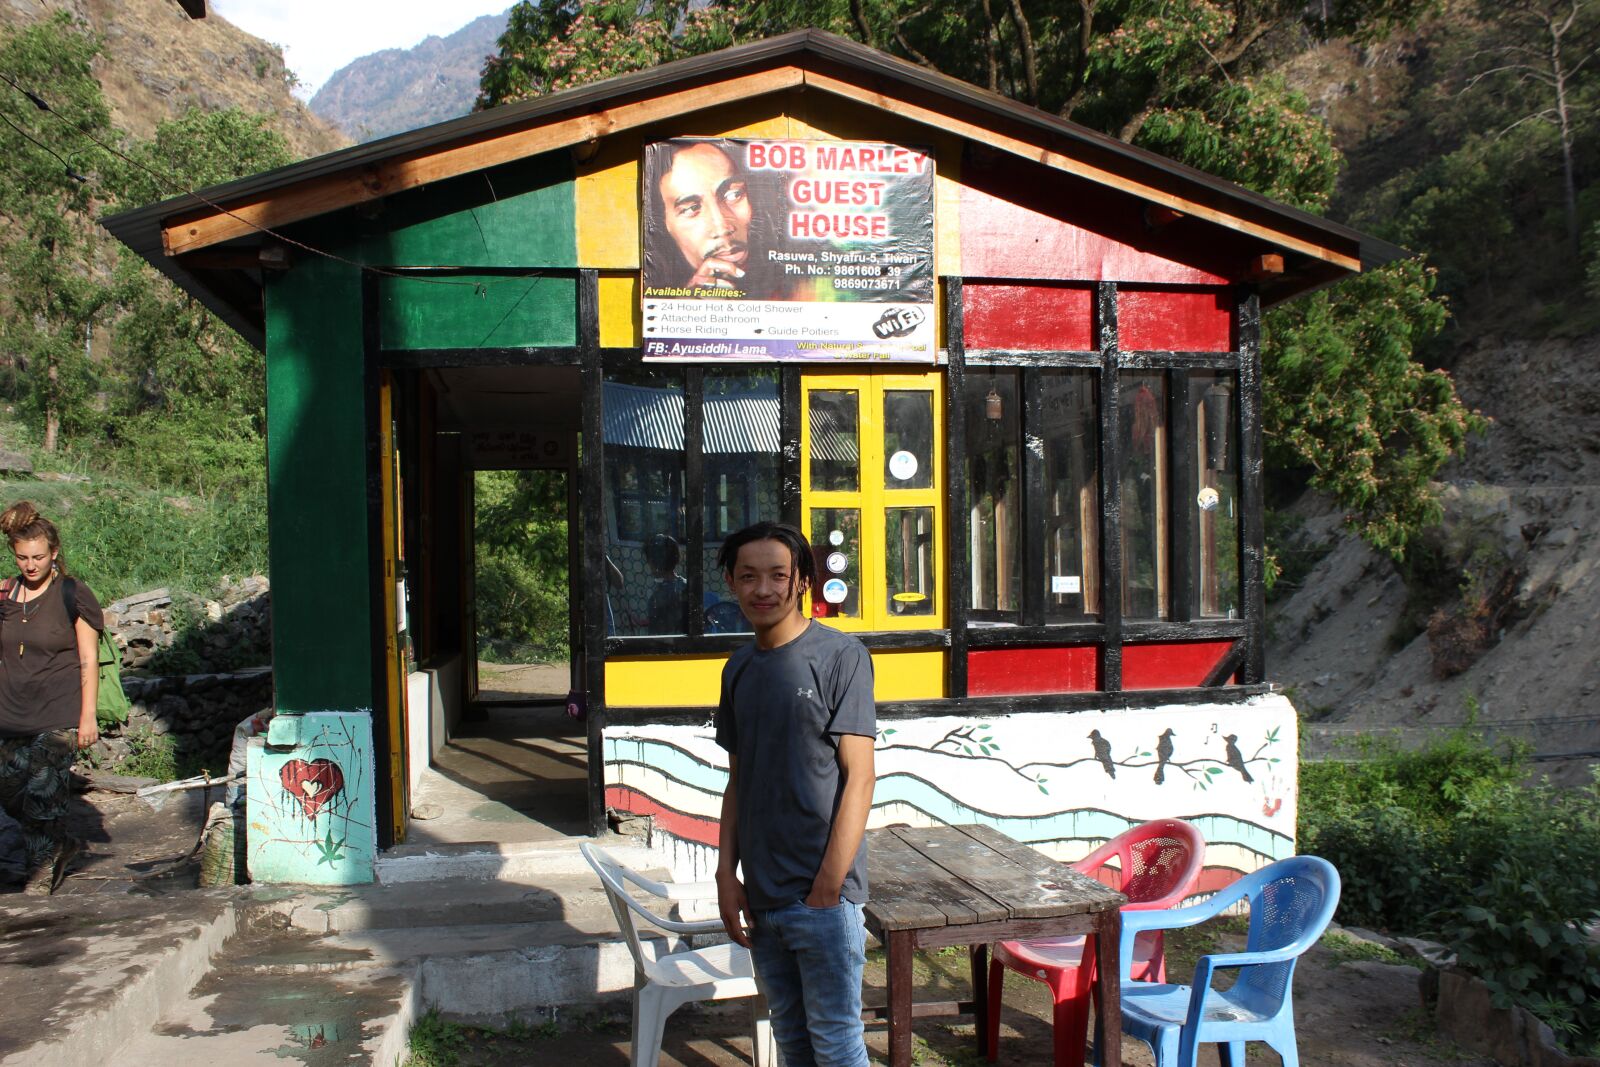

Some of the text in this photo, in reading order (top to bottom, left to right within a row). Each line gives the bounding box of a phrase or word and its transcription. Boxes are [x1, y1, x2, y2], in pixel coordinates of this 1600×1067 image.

[749, 144, 927, 173] BOB MARLEY
[793, 179, 885, 206] GUEST
[791, 214, 886, 239] HOUSE
[768, 250, 818, 263] Rasuwa,
[785, 264, 804, 275] Ph.
[645, 287, 691, 297] Available
[661, 302, 803, 314] 24 Hour Hot & Cold Shower
[661, 314, 760, 325] Attached Bathroom
[661, 325, 728, 336] Horse Riding
[768, 327, 799, 336] Guide
[647, 343, 669, 354] FB:
[734, 344, 767, 356] Lama
[796, 341, 817, 349] With
